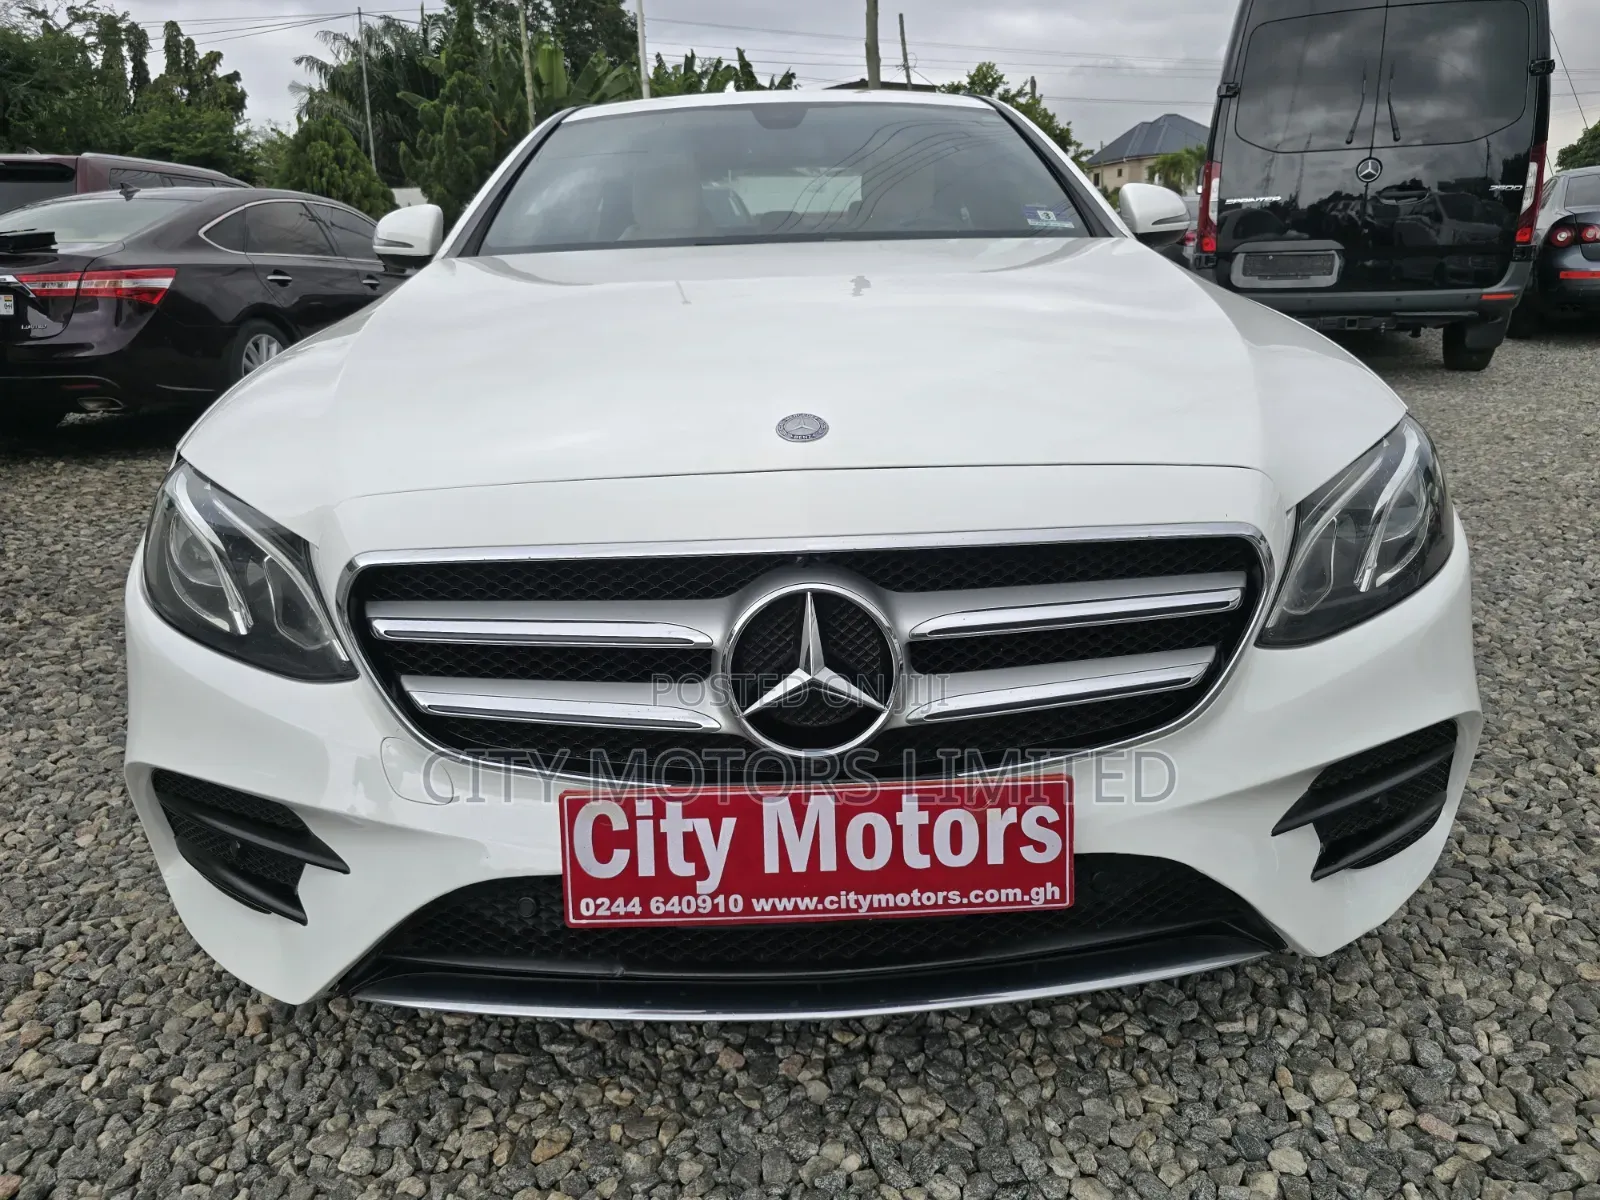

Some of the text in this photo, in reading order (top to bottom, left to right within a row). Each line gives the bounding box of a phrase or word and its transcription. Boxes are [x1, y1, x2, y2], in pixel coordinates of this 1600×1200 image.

[573, 794, 1063, 895] City Motors
[580, 882, 1060, 916] 0244 640910 www.citymotors.com.gh
